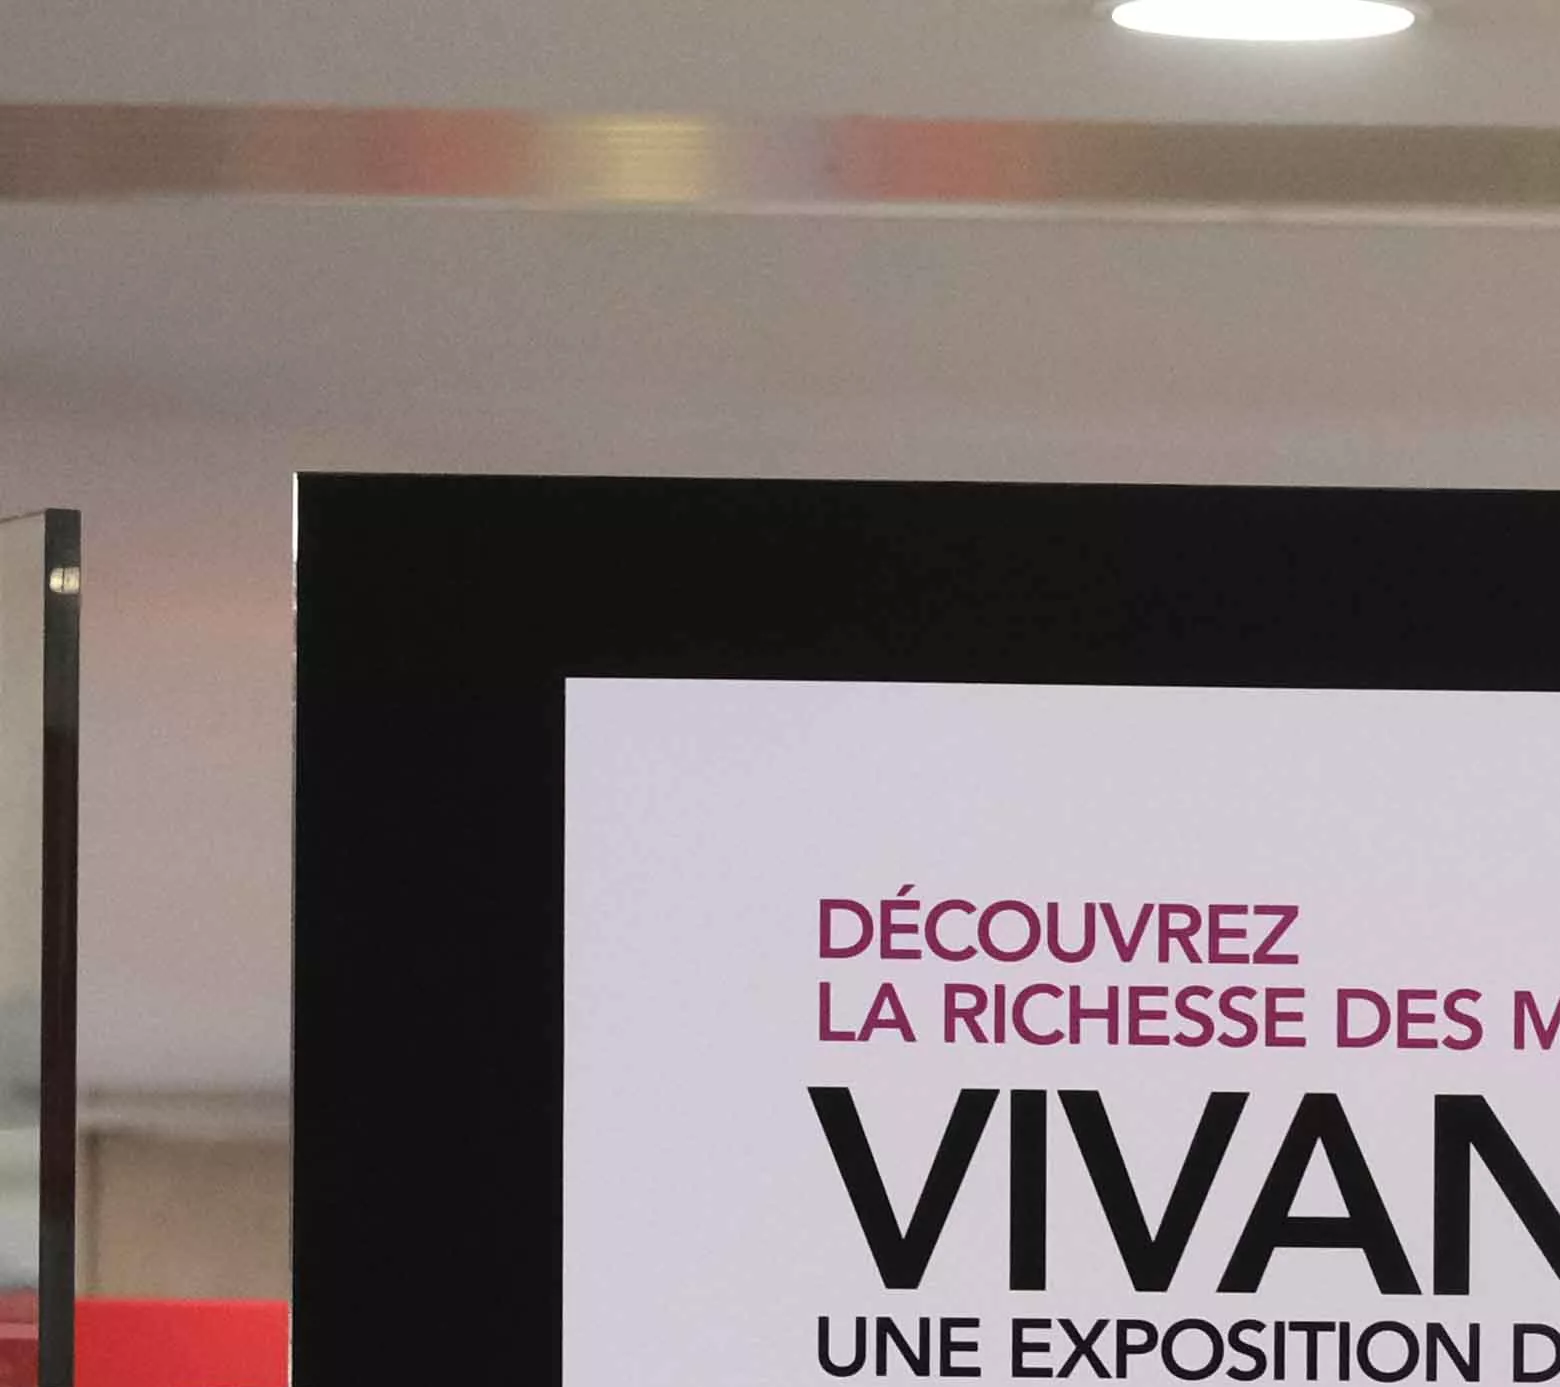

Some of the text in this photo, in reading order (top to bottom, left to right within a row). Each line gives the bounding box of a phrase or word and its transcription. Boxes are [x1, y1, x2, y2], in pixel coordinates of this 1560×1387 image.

[819, 884, 1299, 965] DÉCOUVREZ
[819, 981, 917, 1043] LA
[944, 983, 1306, 1048] RICHESSE
[1337, 988, 1483, 1051] DES
[818, 1316, 981, 1377] UNE
[1012, 1318, 1480, 1383] EXPOSITION
